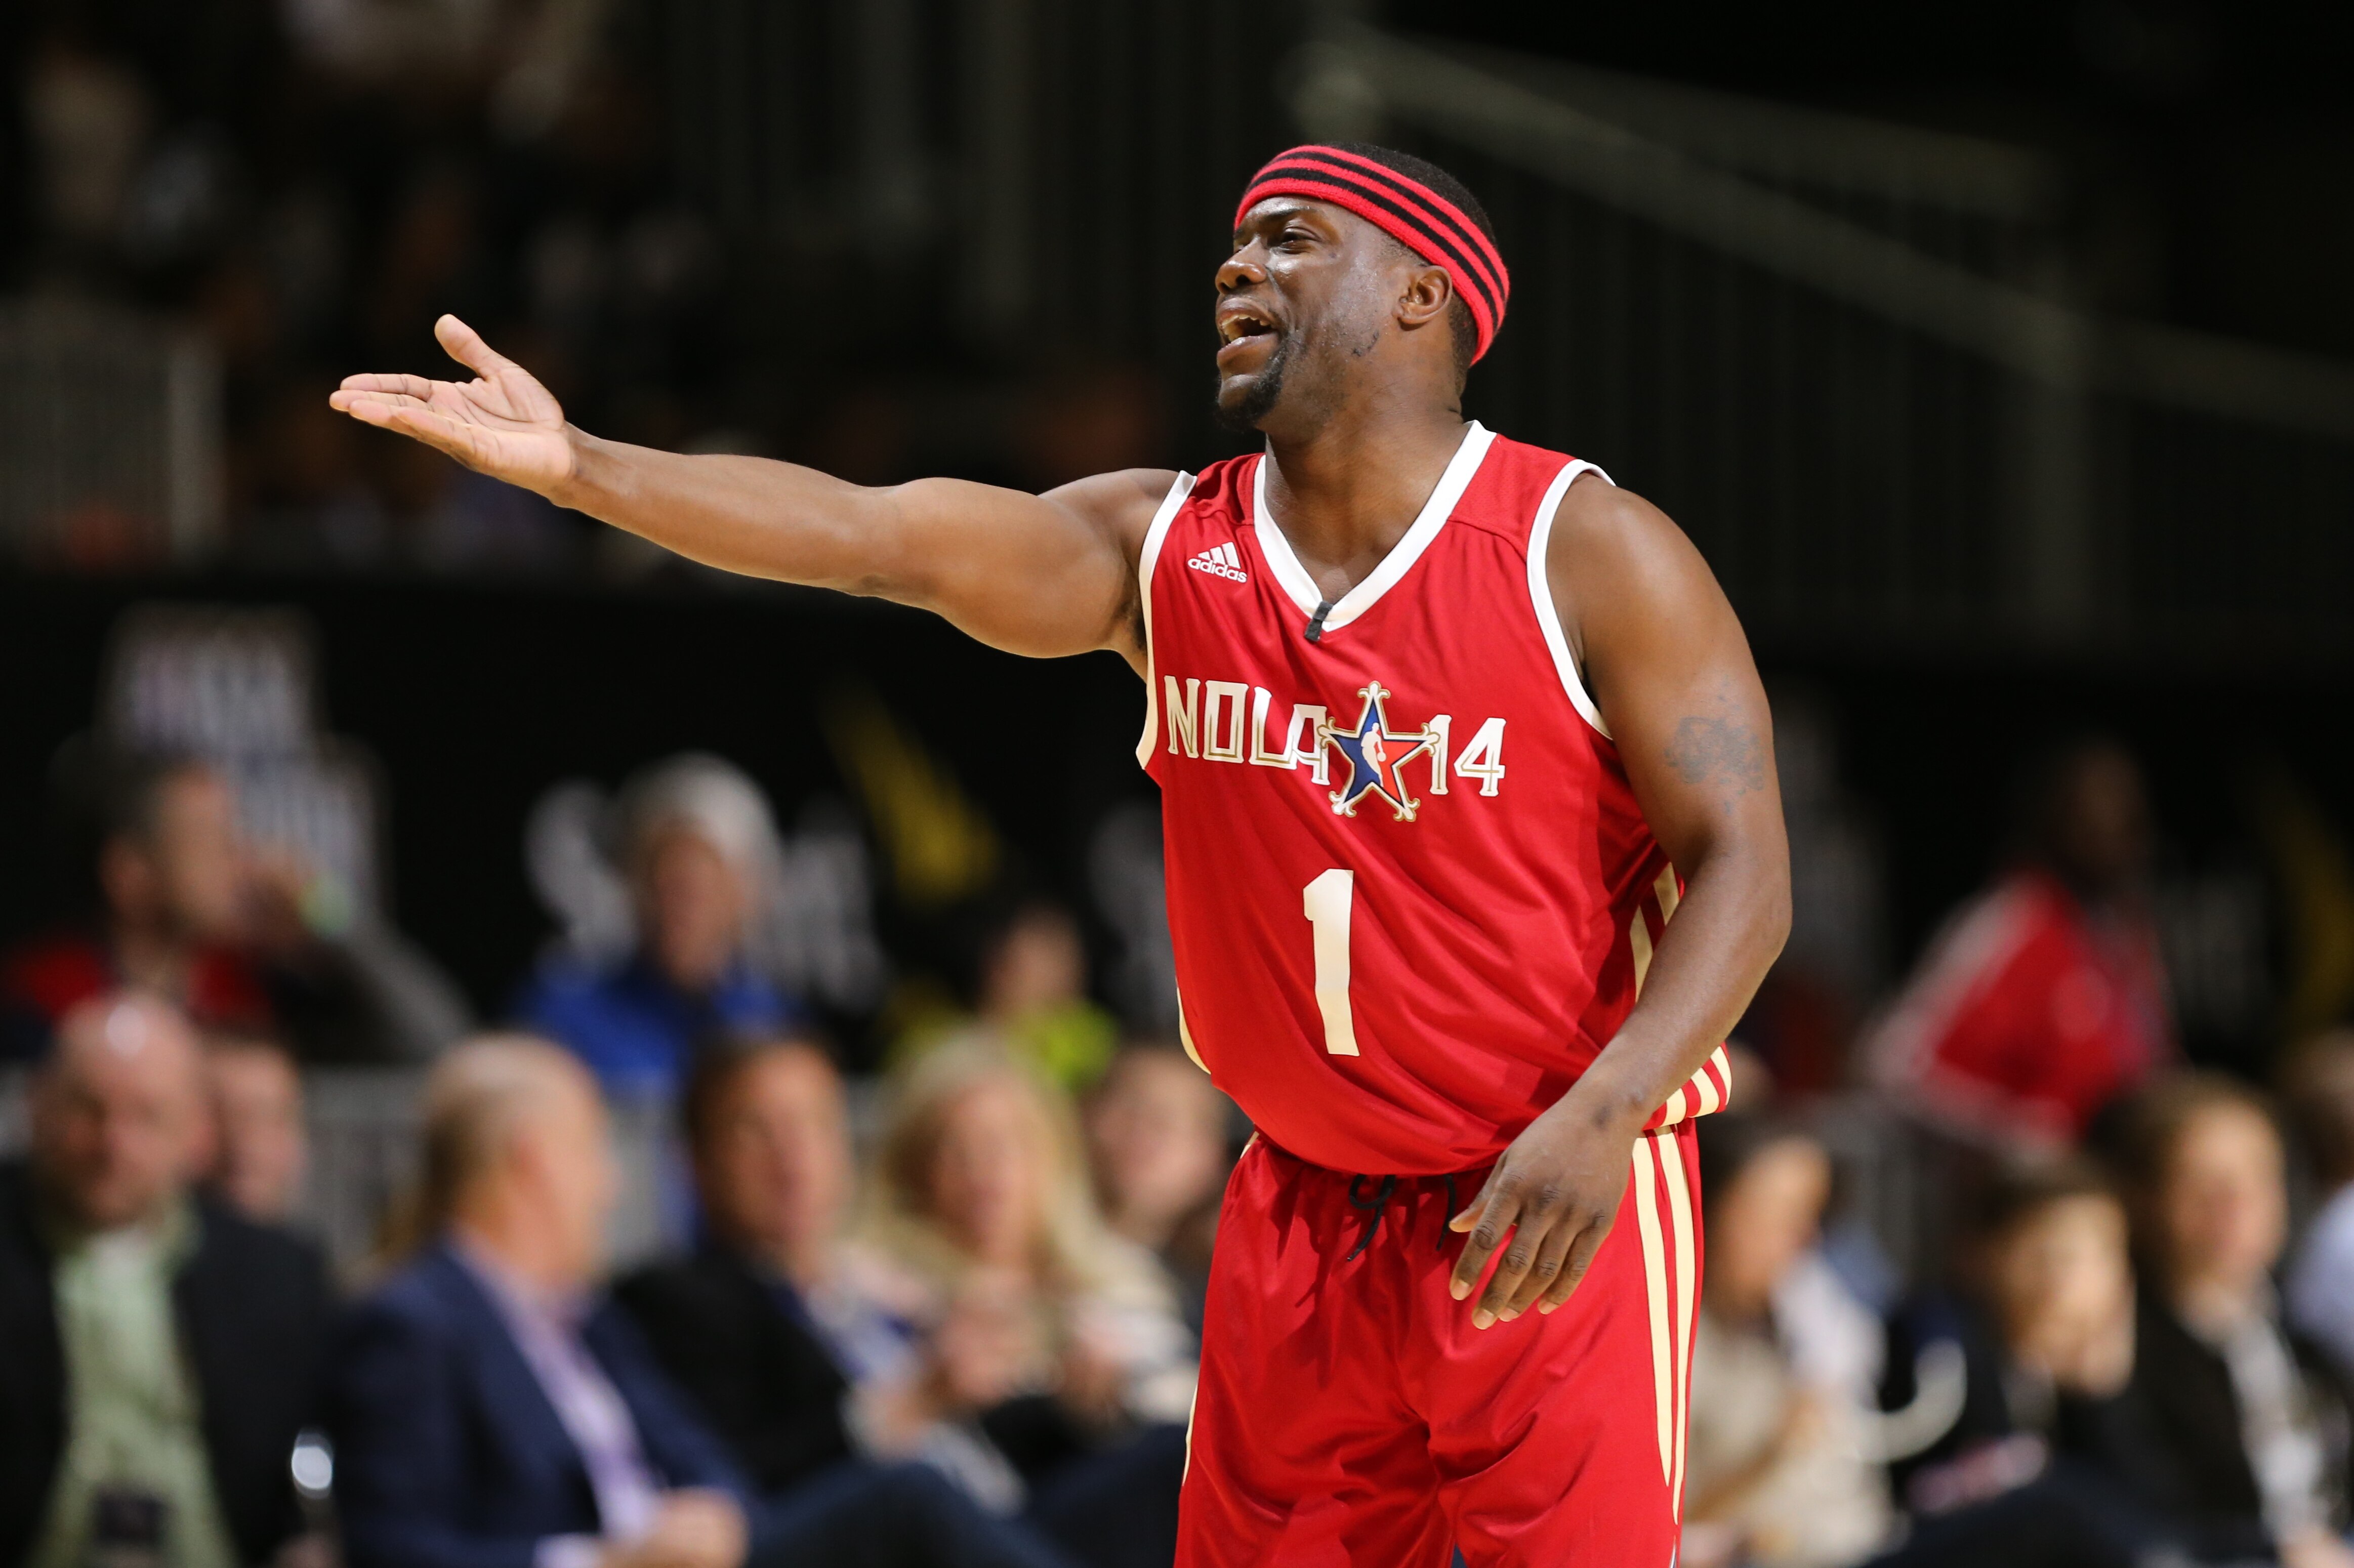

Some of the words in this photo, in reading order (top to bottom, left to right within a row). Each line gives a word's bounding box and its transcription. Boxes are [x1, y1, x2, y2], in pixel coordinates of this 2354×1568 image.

[1187, 558, 1248, 583] adidas
[1164, 676, 1330, 785] NOLA
[1429, 715, 1506, 797] 14
[1303, 869, 1359, 1056] 1
